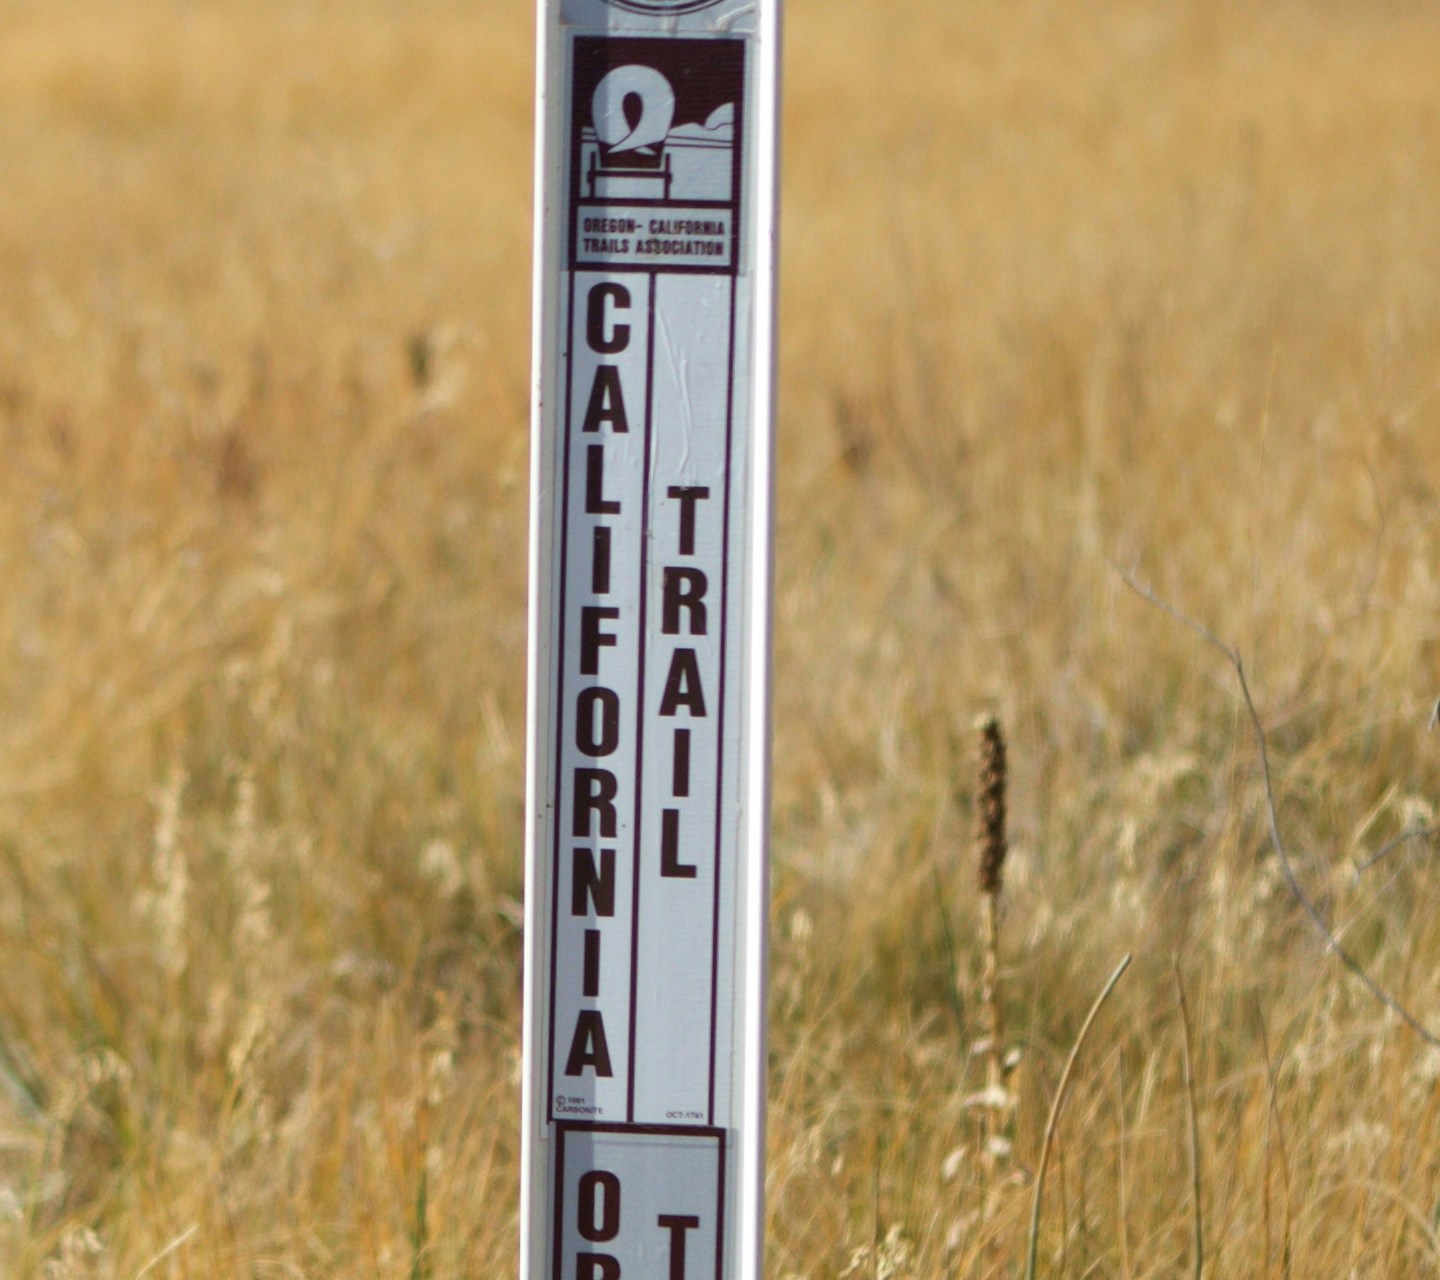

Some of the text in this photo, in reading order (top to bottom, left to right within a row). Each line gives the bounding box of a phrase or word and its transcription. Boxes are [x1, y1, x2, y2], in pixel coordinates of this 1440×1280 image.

[584, 238, 724, 257] TRAILS ASSOCIATION
[648, 219, 725, 236] CALIFORNIA
[565, 282, 630, 1077] CALIFORNIA
[660, 486, 708, 877] TRAIL
